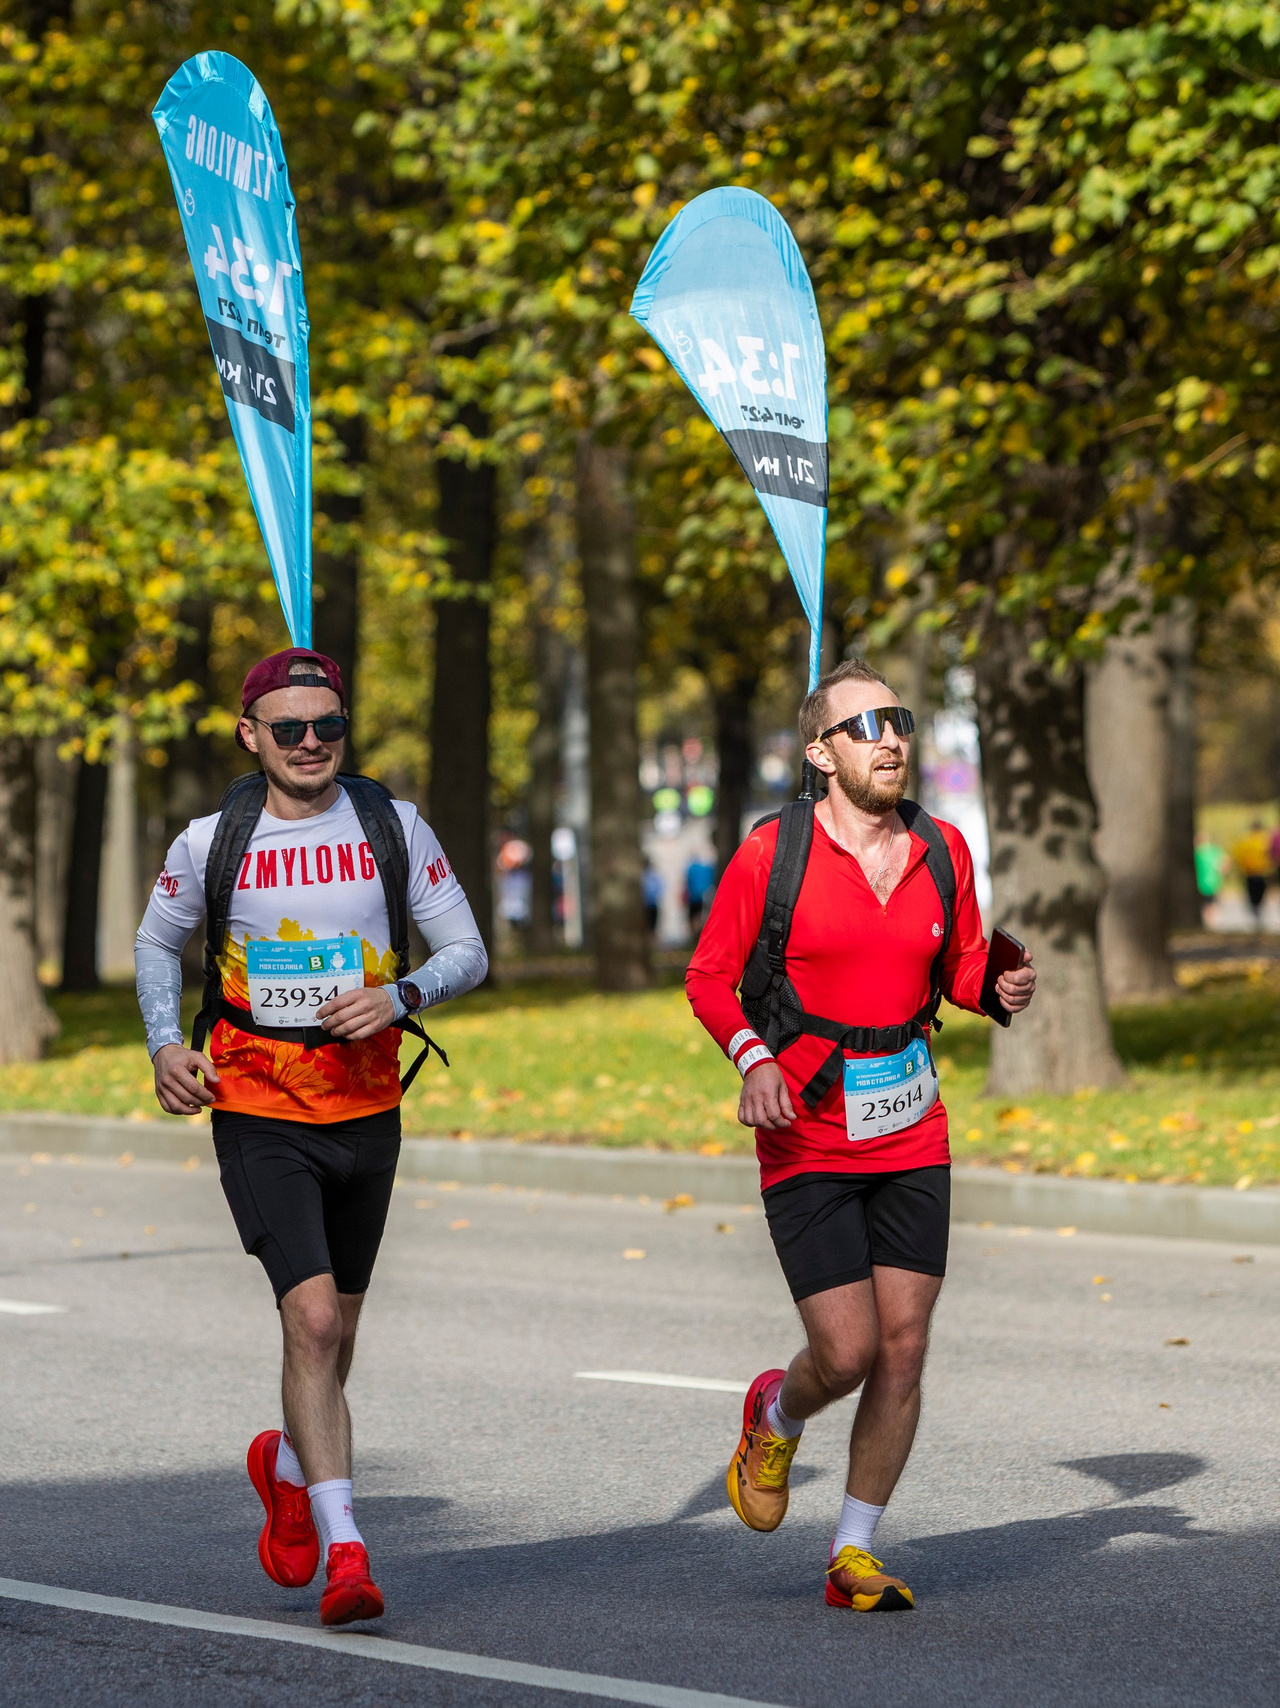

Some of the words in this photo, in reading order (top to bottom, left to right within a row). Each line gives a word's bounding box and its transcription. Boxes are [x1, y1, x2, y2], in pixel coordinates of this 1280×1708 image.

[233, 841, 376, 891] ZMYLONG
[272, 963, 303, 971] СТОЛИЦА
[260, 985, 339, 1008] 23934
[856, 1079, 871, 1087] МОЯ
[871, 1073, 901, 1085] СТОЛИЦА
[861, 1083, 923, 1122] 23614
